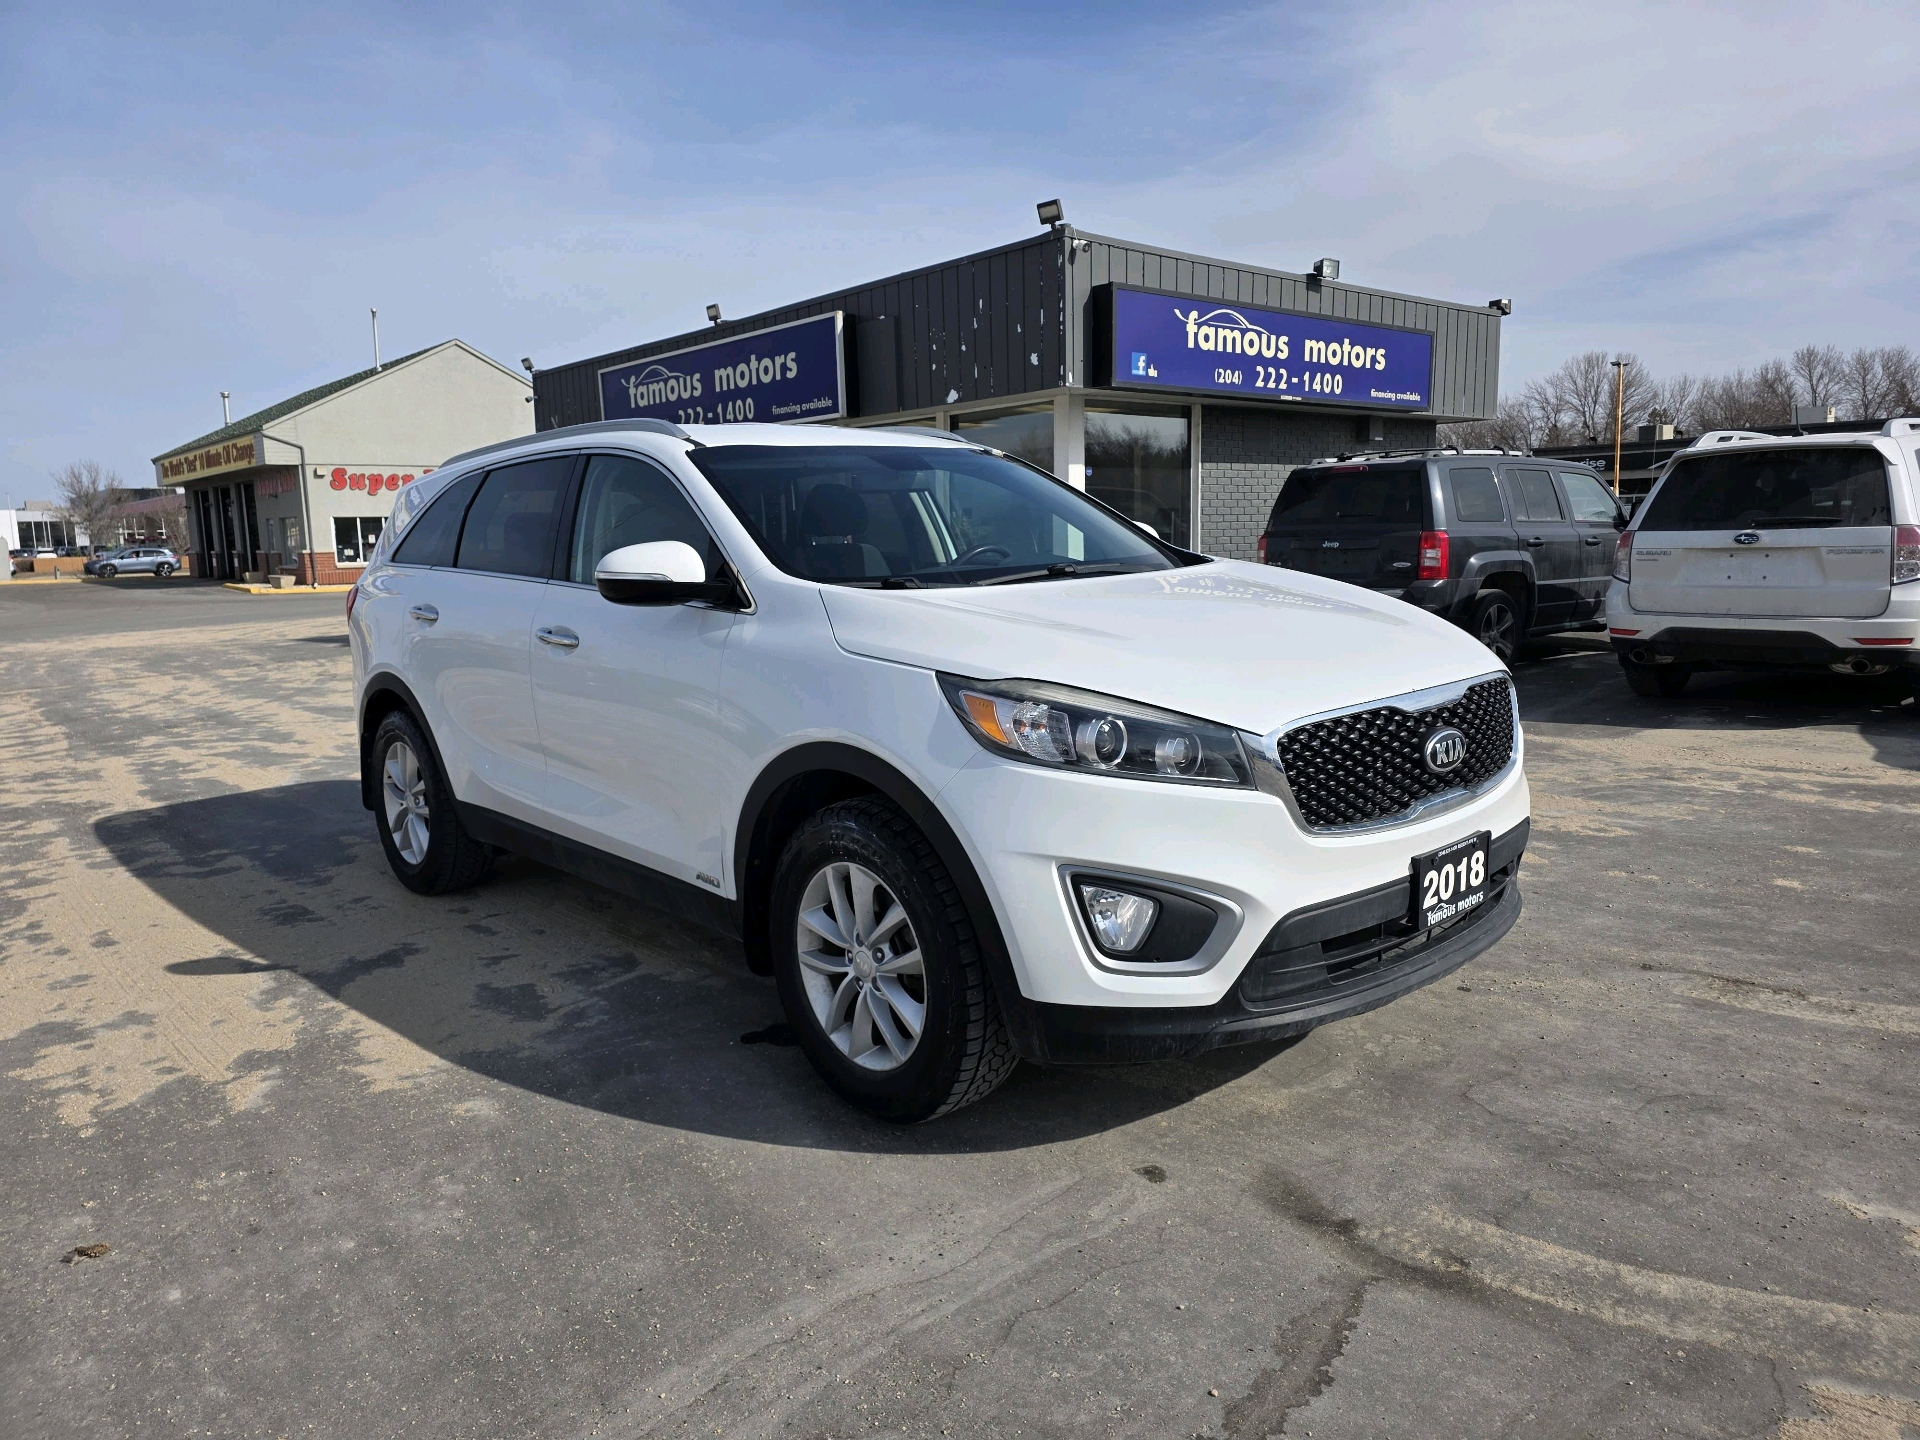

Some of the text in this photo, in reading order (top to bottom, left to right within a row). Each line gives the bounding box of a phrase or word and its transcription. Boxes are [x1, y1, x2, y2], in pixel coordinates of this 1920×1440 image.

[1186, 310, 1386, 371] famous motors
[629, 351, 798, 409] famous motors
[1214, 365, 1343, 395] (204) 222-1400
[772, 397, 833, 416] financing available
[1370, 388, 1421, 402] financing available
[222, 444, 232, 466] Oil
[231, 442, 255, 466] Change
[330, 467, 415, 496] Super
[1322, 540, 1340, 549] Jeep
[1434, 737, 1464, 766] KIA
[1422, 850, 1485, 910] 2018
[1427, 891, 1484, 927] famous motors
